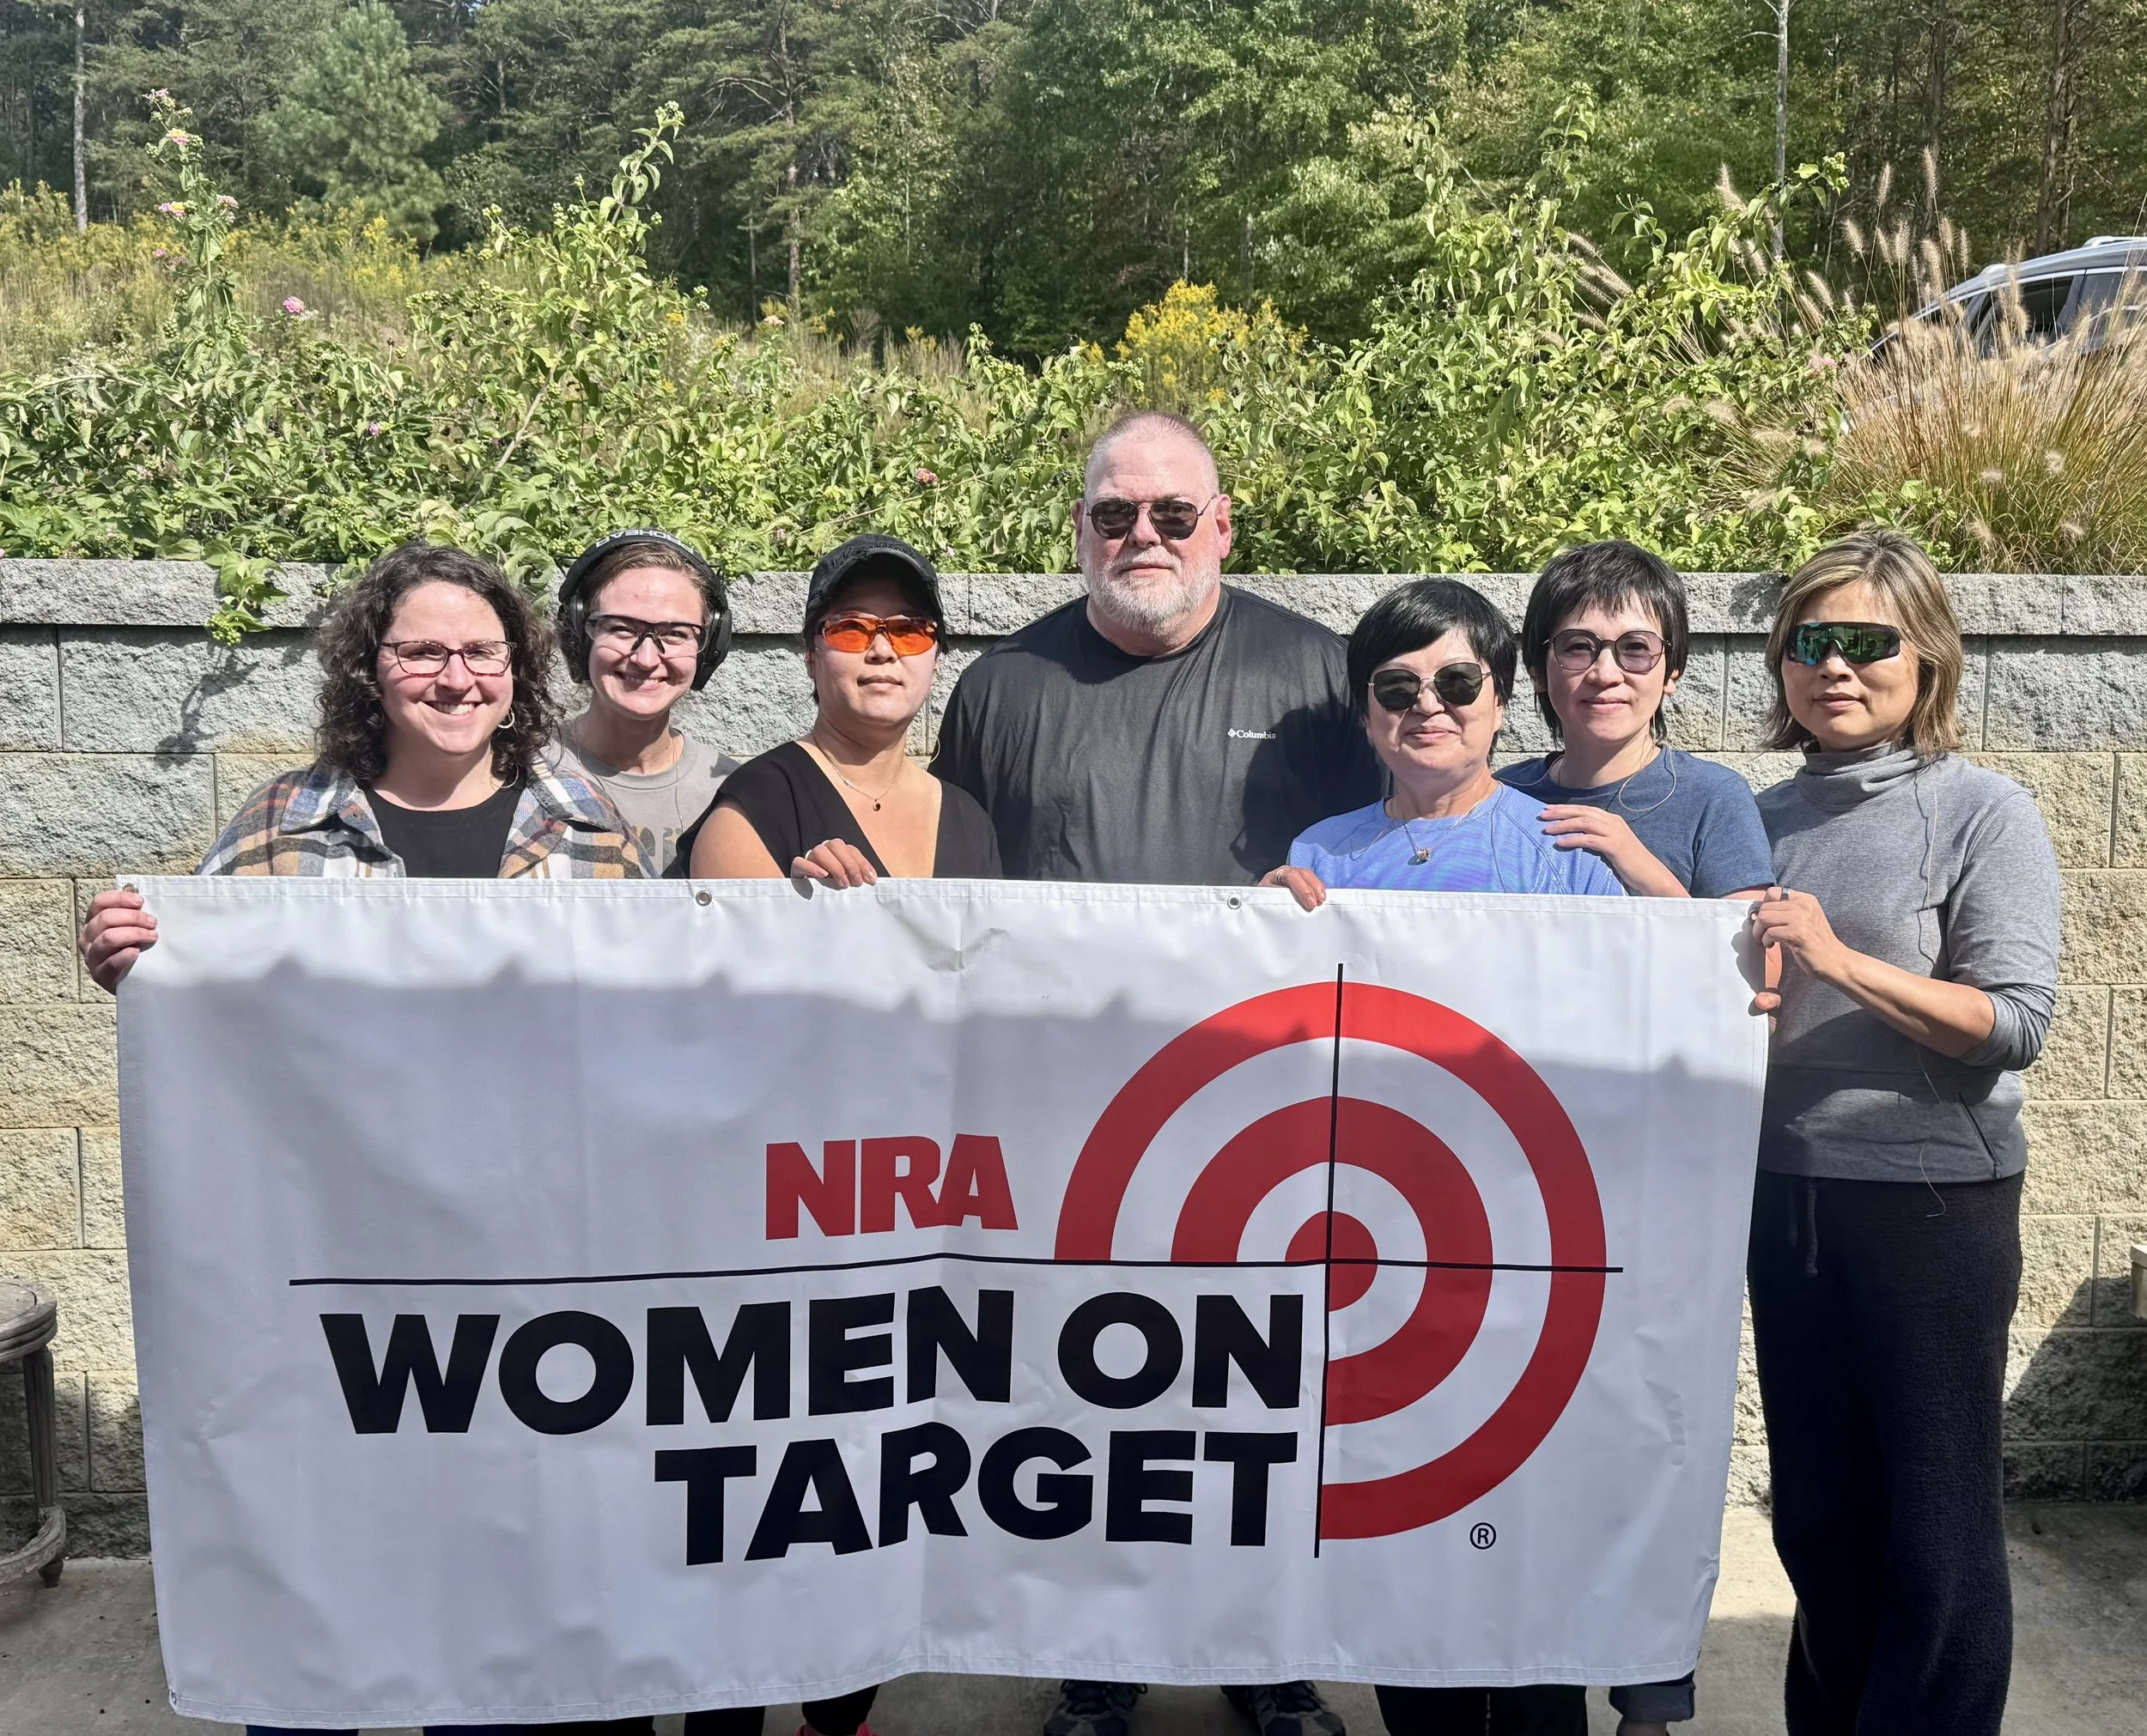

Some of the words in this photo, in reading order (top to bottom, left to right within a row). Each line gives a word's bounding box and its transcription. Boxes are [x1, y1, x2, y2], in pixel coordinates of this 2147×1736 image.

[1236, 729, 1276, 739] Columbia
[766, 1134, 1018, 1240] NRA
[319, 1285, 1014, 1436] WOMEN
[1057, 1291, 1304, 1410] ON
[654, 1421, 1299, 1566] TARGET
